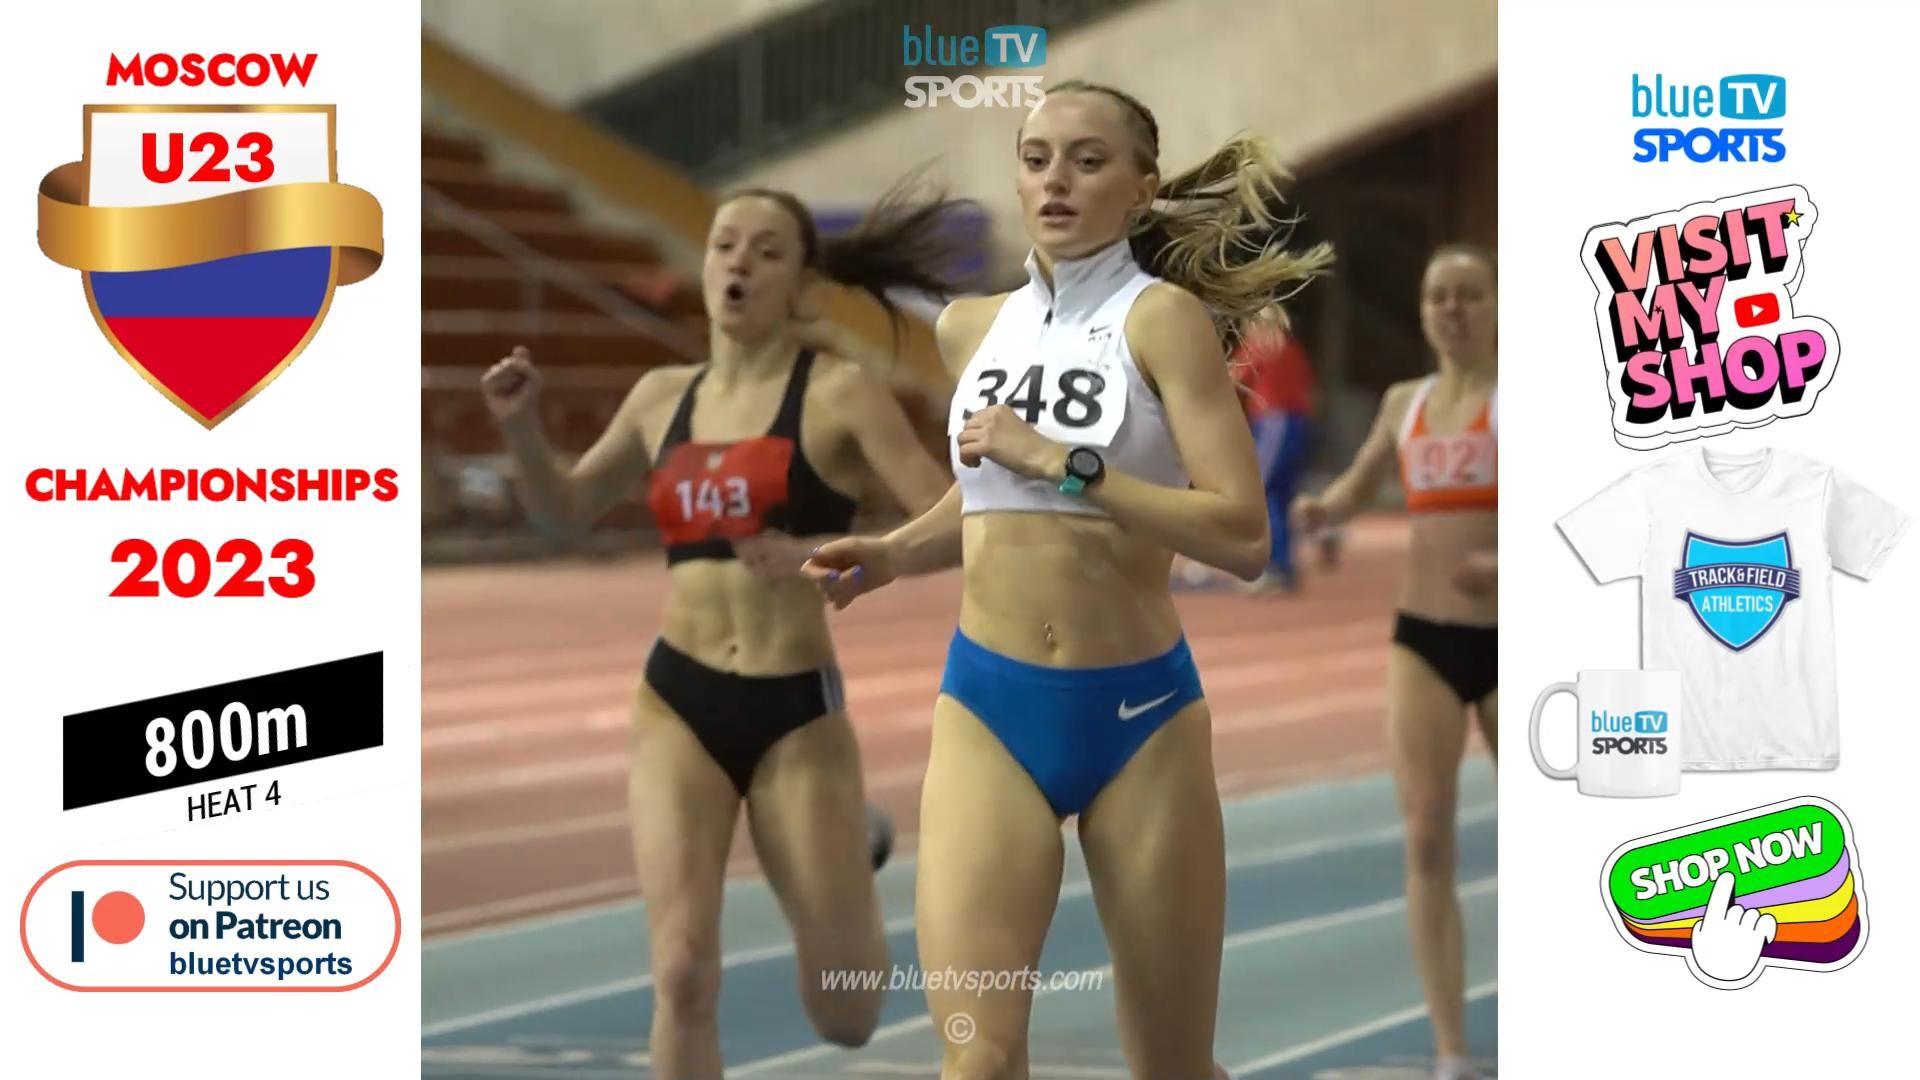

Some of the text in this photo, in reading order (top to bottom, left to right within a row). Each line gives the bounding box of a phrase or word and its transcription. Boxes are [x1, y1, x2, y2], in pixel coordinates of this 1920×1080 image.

[963, 364, 1106, 428] 348
[676, 477, 751, 521] 143
[1701, 595, 1774, 612] ATHLETICS
[1592, 710, 1664, 732] blue TV
[1592, 736, 1668, 755] SPORTS
